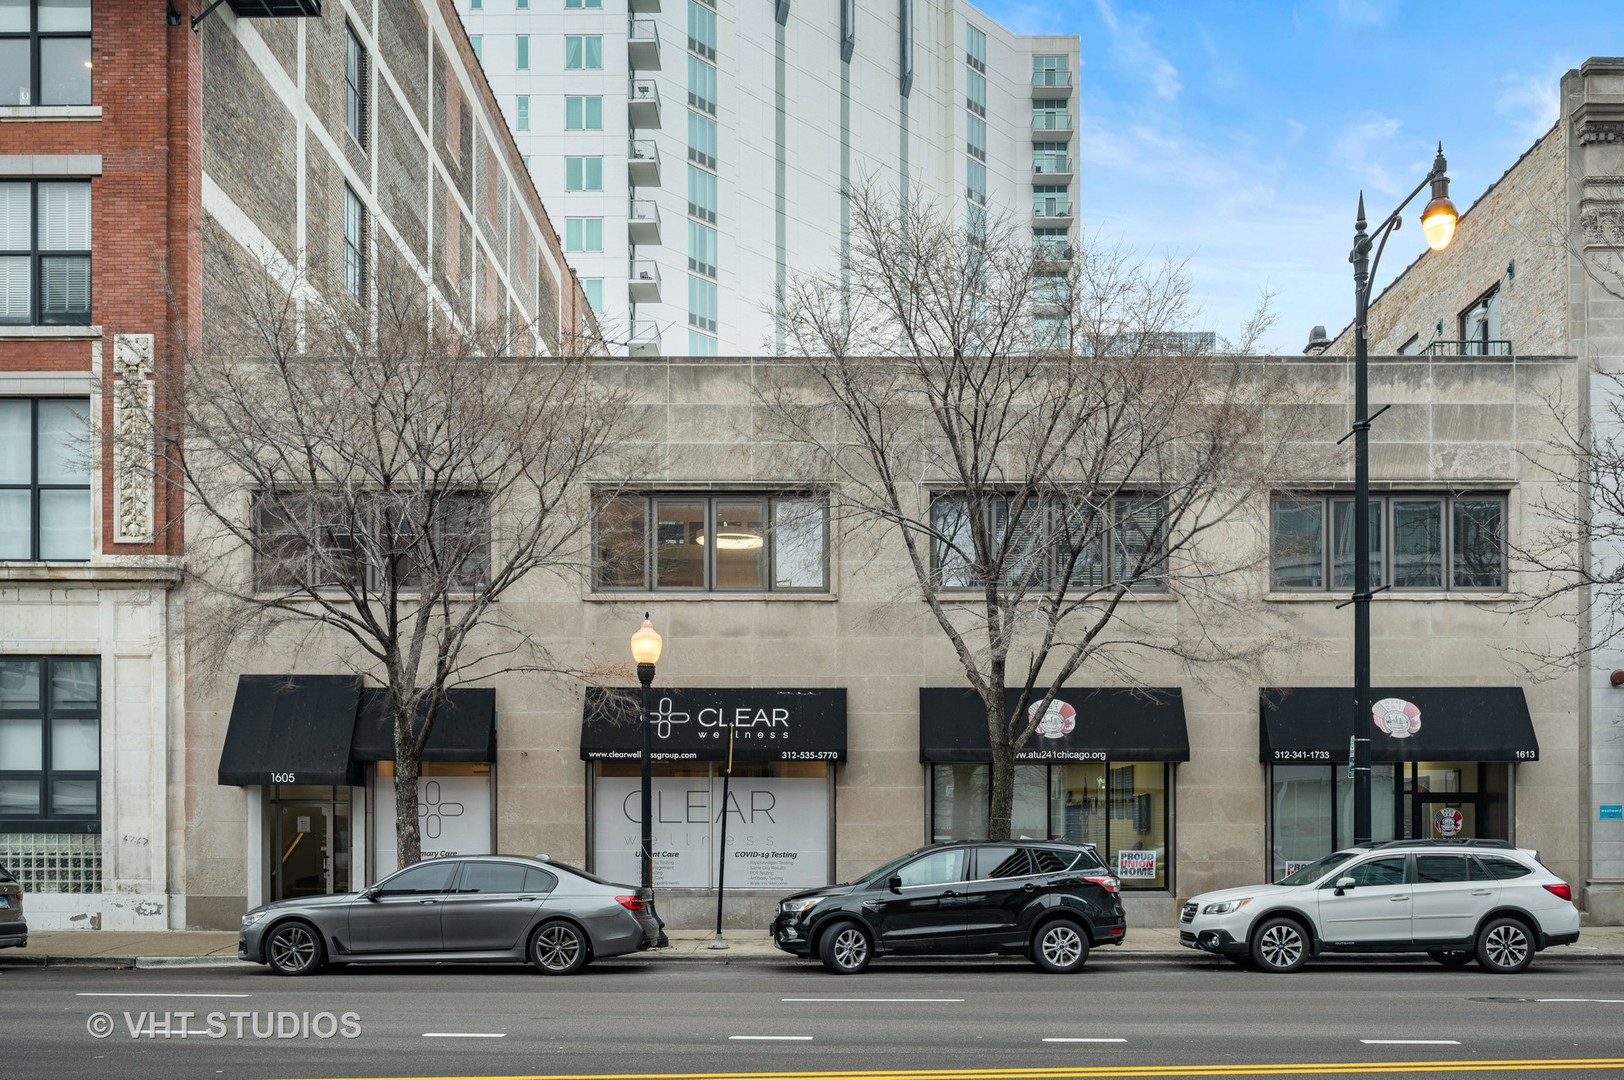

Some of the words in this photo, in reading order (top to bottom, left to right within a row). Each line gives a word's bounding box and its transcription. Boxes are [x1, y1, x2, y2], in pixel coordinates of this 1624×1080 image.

[698, 708, 789, 728] CLEAR
[698, 730, 789, 739] welness
[588, 750, 697, 760] www.clearwellssgroup.com
[782, 751, 838, 759] 312-535-5770
[1274, 750, 1330, 759] 312-341-1733
[1515, 750, 1536, 759] 1613
[271, 772, 296, 783] 1605
[623, 790, 776, 824] CLEAR
[420, 850, 439, 859] mary
[734, 851, 770, 859] COVID-19
[771, 851, 798, 860] Testing
[1120, 860, 1154, 868] UNION
